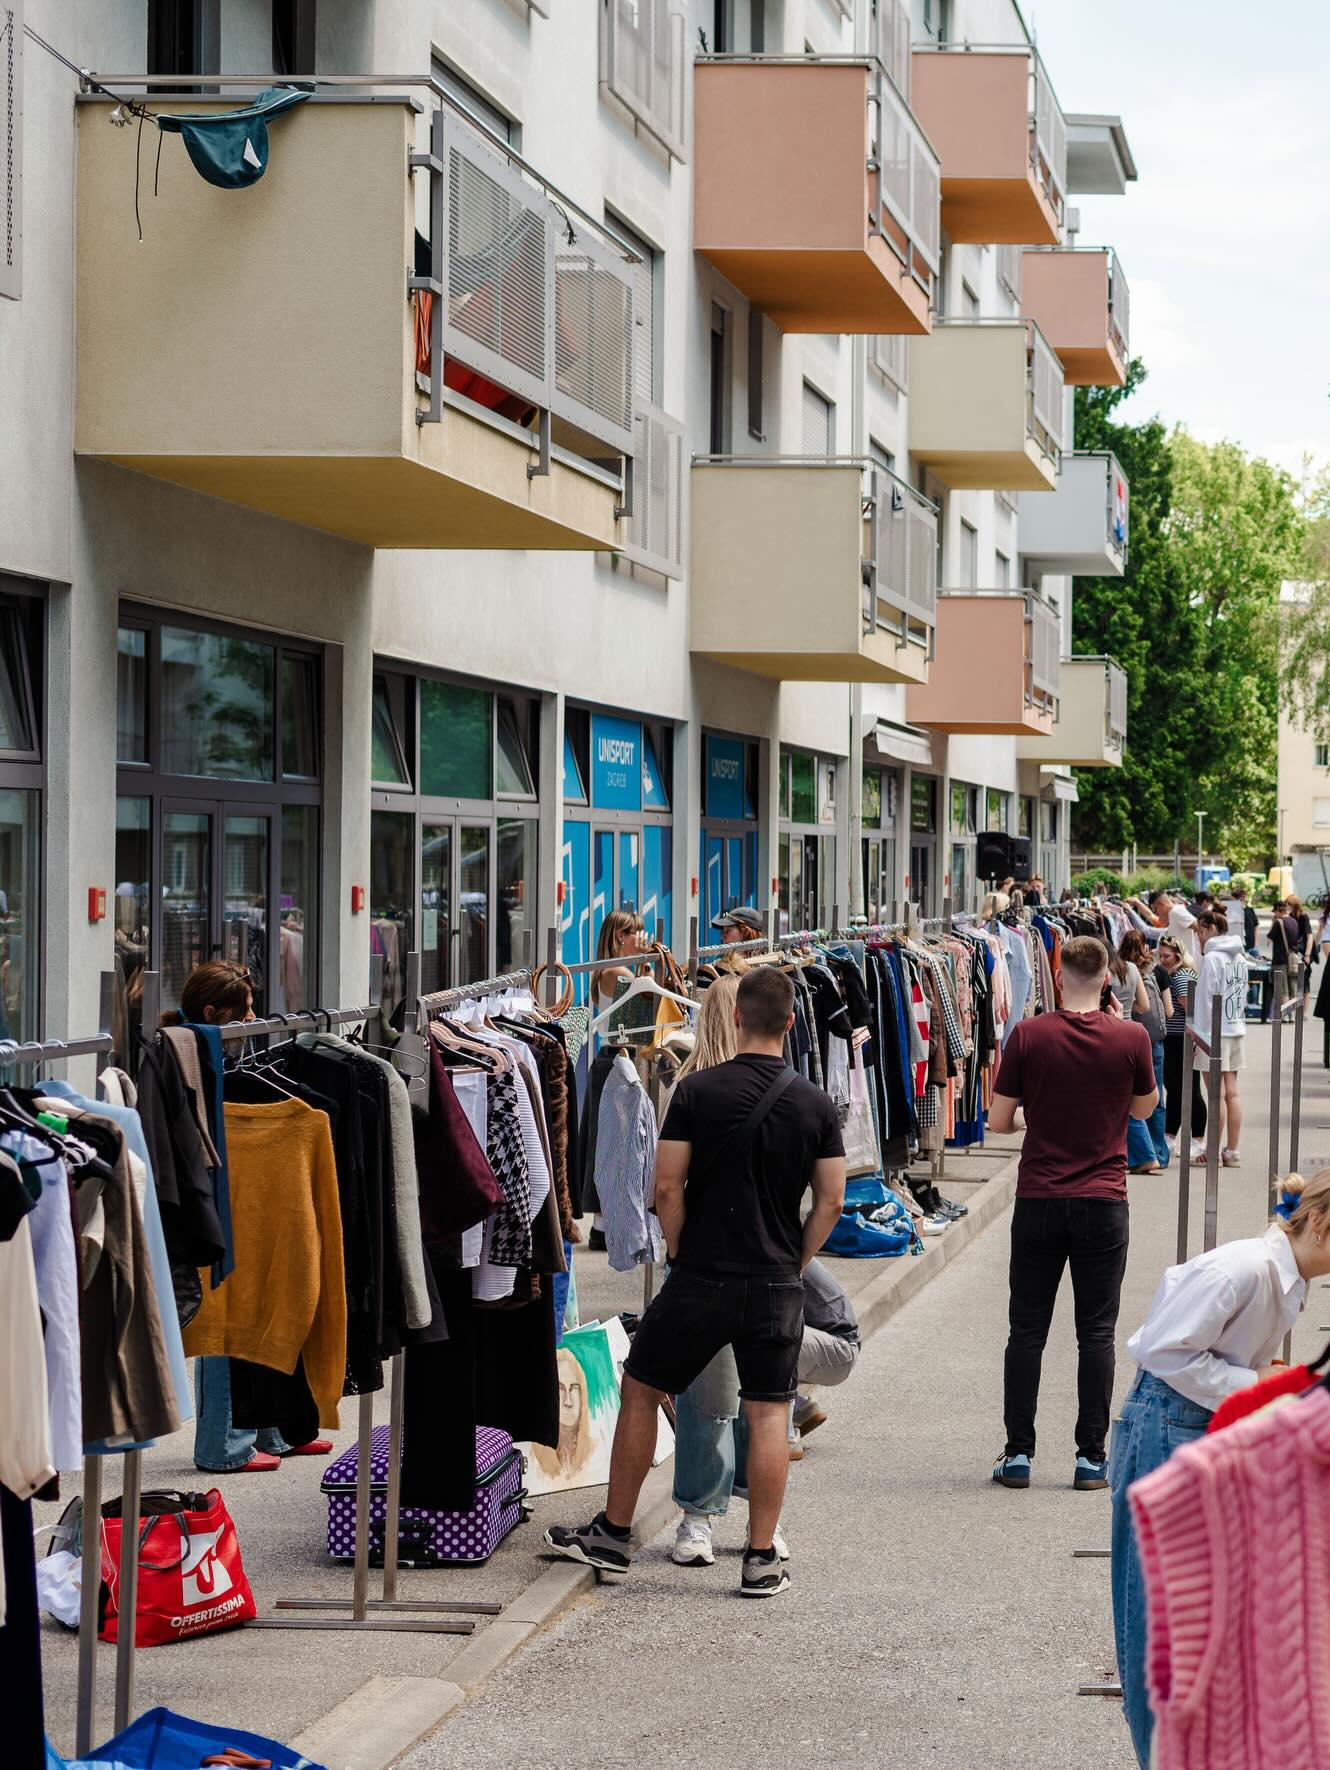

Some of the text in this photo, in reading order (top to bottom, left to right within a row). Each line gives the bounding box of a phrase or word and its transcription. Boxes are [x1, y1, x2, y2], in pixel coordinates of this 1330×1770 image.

[598, 737, 635, 766] UNISPORT
[607, 771, 627, 788] ZAGREB
[711, 757, 739, 781] UNISPORT
[170, 1593, 246, 1628] OFFERTISSIMA
